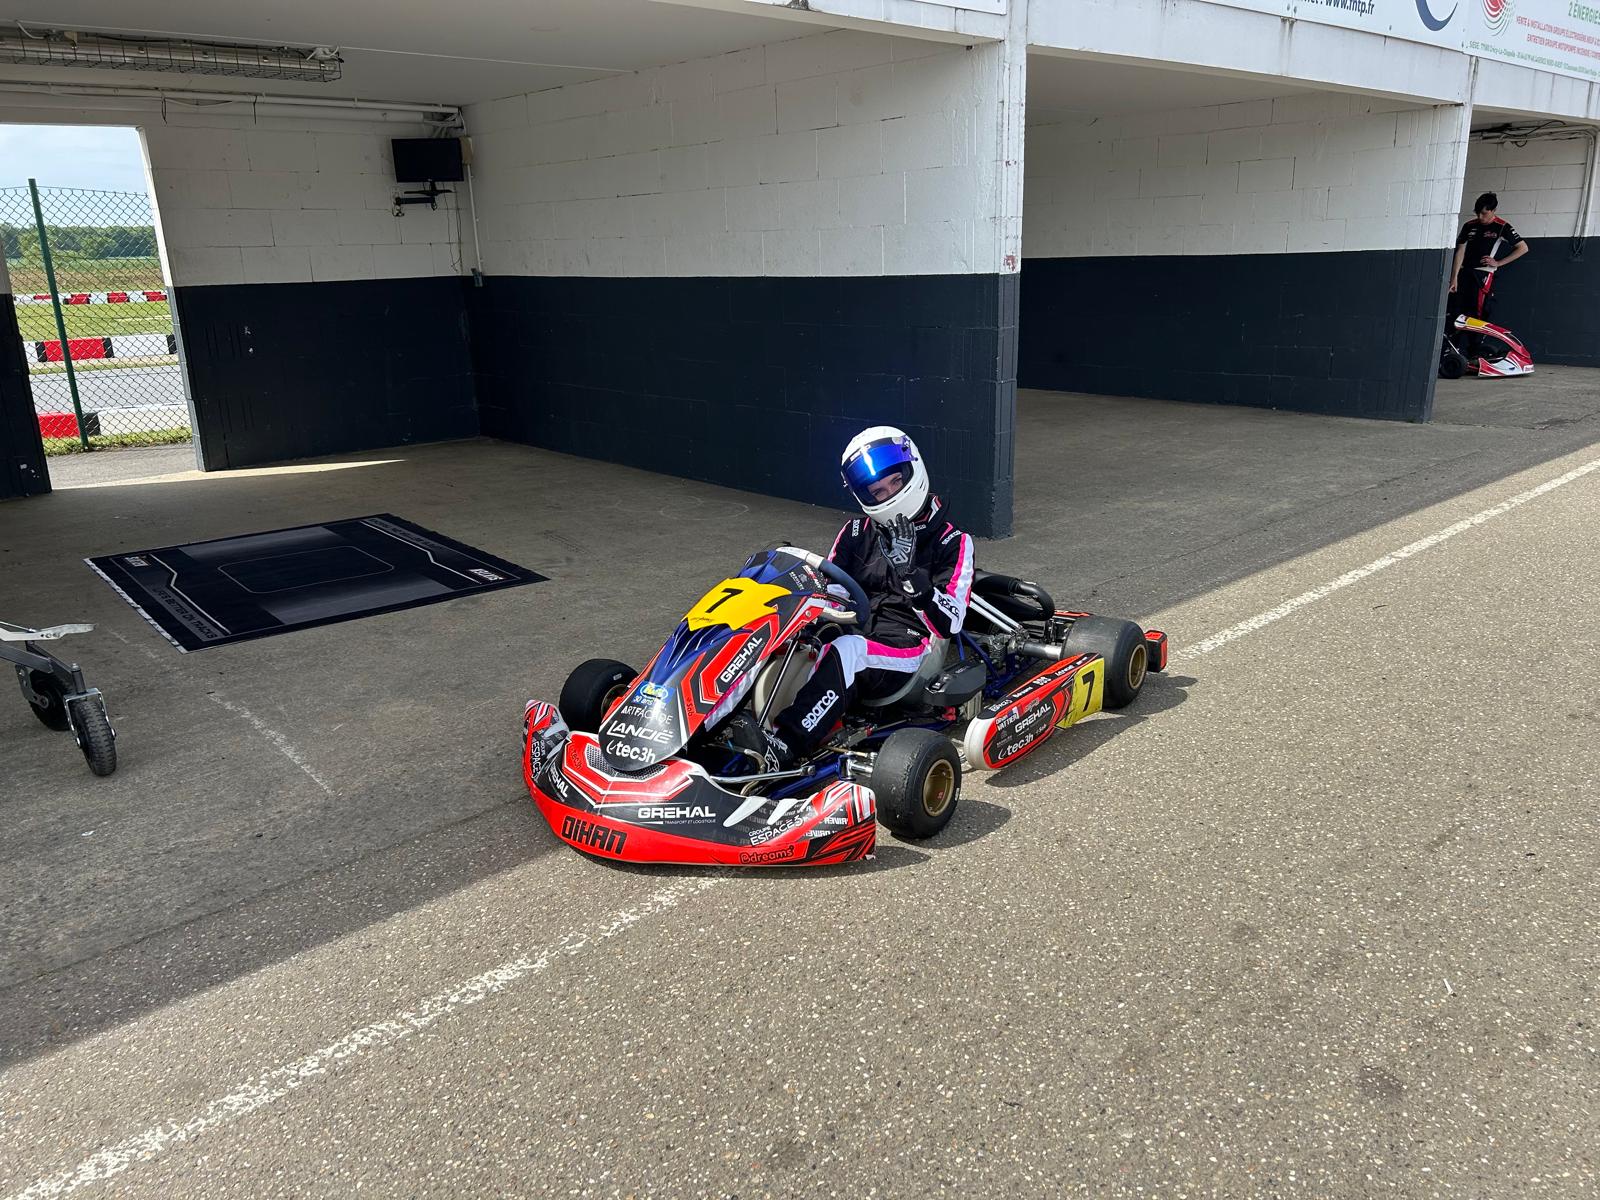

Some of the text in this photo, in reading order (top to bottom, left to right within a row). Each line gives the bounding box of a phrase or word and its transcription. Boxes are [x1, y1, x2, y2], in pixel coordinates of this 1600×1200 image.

[705, 587, 745, 614] 7
[720, 636, 763, 683] GREHAL
[1081, 670, 1095, 713] 7
[801, 689, 839, 732] sparco
[1014, 703, 1052, 734] GREHAL
[615, 740, 656, 764] tec3h
[1006, 732, 1034, 757] tec3h
[637, 806, 717, 819] GREHAL
